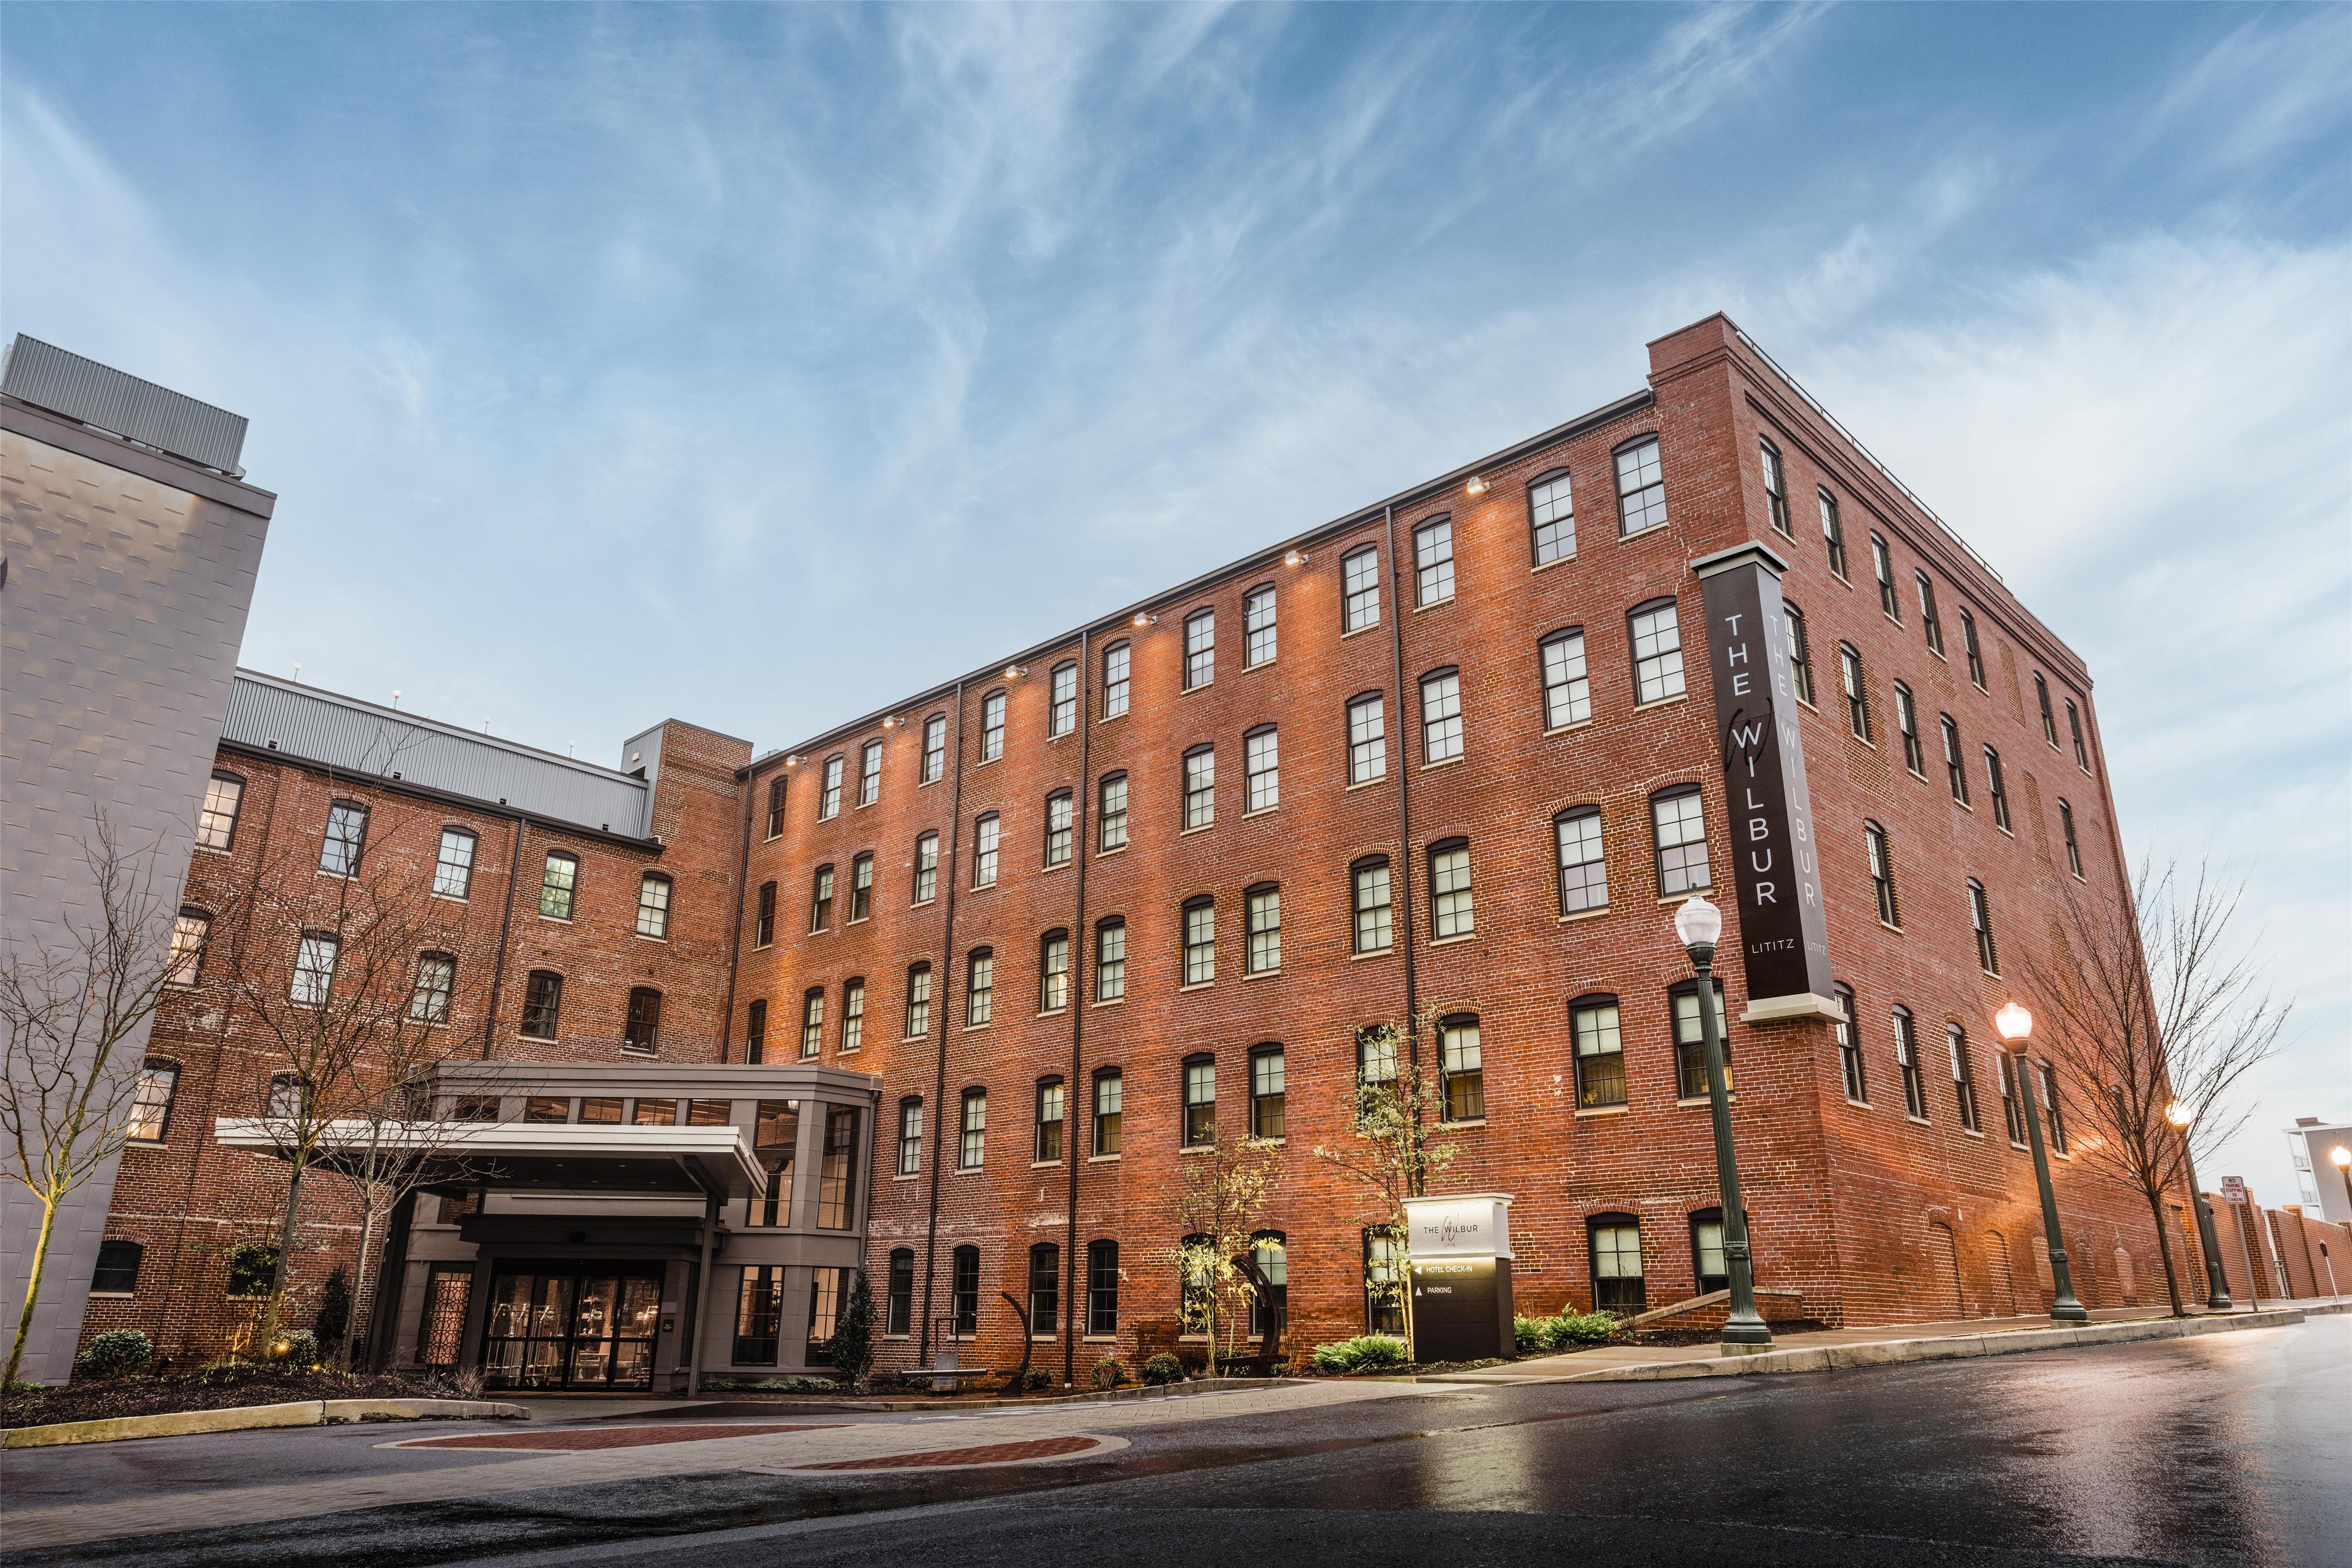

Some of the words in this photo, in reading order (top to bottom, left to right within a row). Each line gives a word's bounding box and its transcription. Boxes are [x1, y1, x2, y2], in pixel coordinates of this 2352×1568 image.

[1725, 614, 1751, 696] THE
[1770, 614, 1788, 697] THE
[1781, 722, 1816, 908] WILBUR
[1731, 722, 1777, 906] WILBUR
[1751, 938, 1795, 954] LITITZ
[1806, 940, 1826, 955] LITITZ
